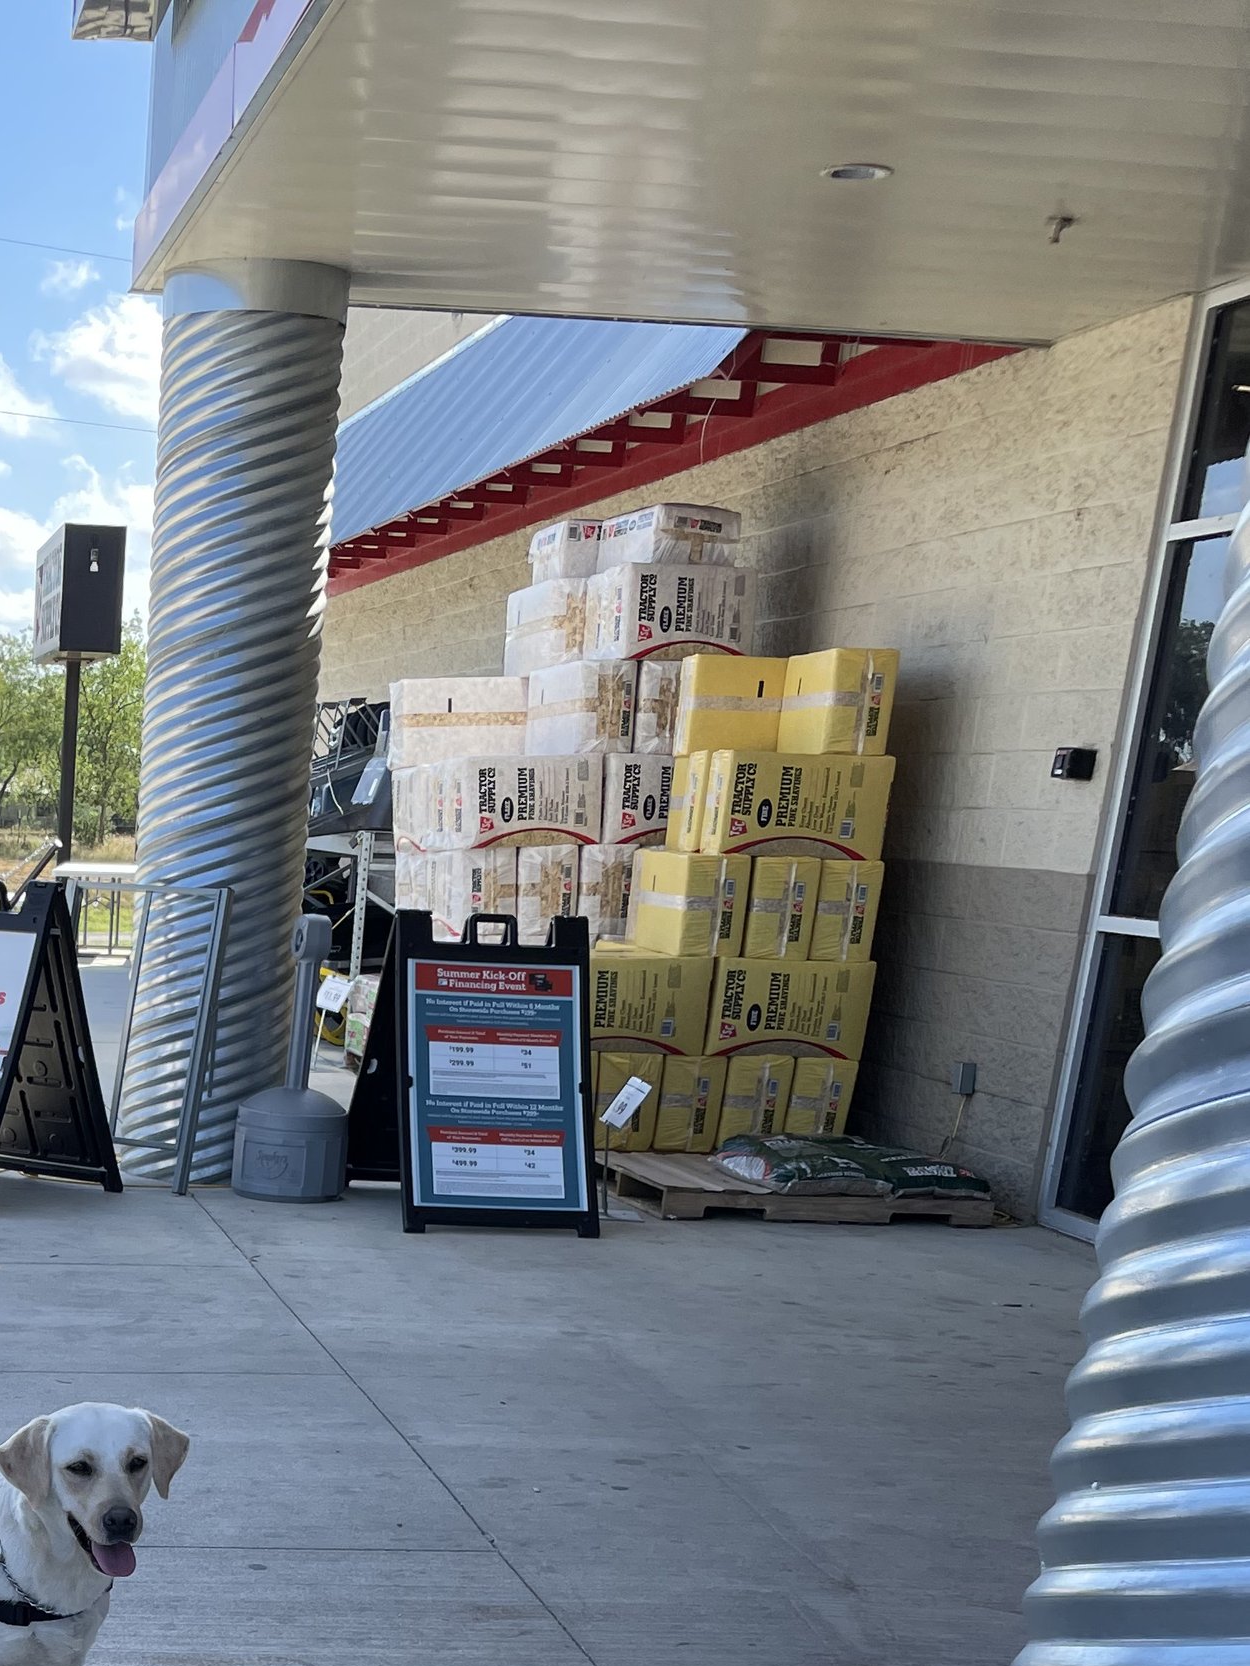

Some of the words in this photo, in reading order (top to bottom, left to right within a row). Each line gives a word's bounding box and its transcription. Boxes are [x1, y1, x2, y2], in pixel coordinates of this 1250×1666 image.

[638, 573, 649, 622] TRACTOR
[647, 586, 656, 622] SUPPLY
[675, 576, 688, 632] PREMIUM
[687, 578, 695, 612] SHAVINGS
[479, 767, 487, 814] TRACTOR
[488, 780, 496, 814] SUPPLY
[517, 767, 527, 821] PREMIUM
[622, 763, 633, 810] TRACTOR
[631, 775, 640, 810] SUPPLY
[658, 766, 671, 819] PREMIUM
[731, 763, 747, 815] TRACTOR
[742, 775, 756, 816] SUPPLY
[775, 766, 794, 827] PREMIUM
[792, 767, 803, 806] SHAVINGS
[730, 819, 746, 836] TSC
[788, 807, 798, 827] PINE
[437, 968, 481, 979] Summer
[482, 970, 526, 981] Kick-Off
[449, 979, 497, 991] Financing
[498, 981, 526, 991] Event
[609, 971, 618, 1008] SHAVINGS
[436, 999, 462, 1007] Interest
[534, 1003, 560, 1011] Months
[594, 970, 610, 1028] PREMIUM
[721, 969, 737, 1020] TRACTOR
[732, 982, 745, 1020] SUPPLY
[764, 972, 782, 1030] PREMIUM
[776, 1012, 786, 1030] PINE
[781, 973, 791, 1010] SHAVINGS
[606, 1009, 616, 1028] PINE
[719, 1023, 735, 1039] TSC
[538, 1104, 564, 1112] Months
